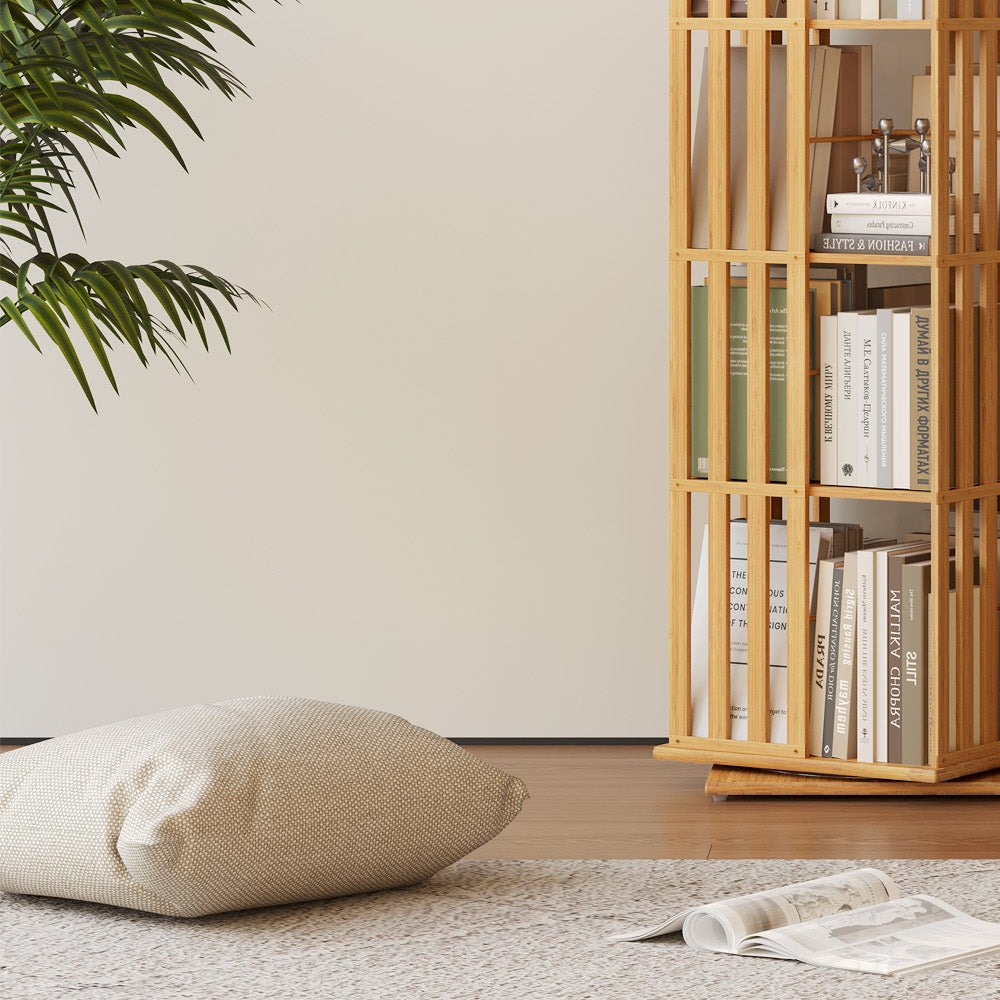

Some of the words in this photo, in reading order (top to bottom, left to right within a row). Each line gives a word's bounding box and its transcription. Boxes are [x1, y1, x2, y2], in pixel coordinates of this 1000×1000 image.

[916, 315, 931, 356] ДУМАЙ
[917, 358, 930, 366] В
[916, 368, 930, 413] ДРУГИХ
[916, 415, 930, 475] ФОРМАТАХ
[732, 571, 747, 579] THE
